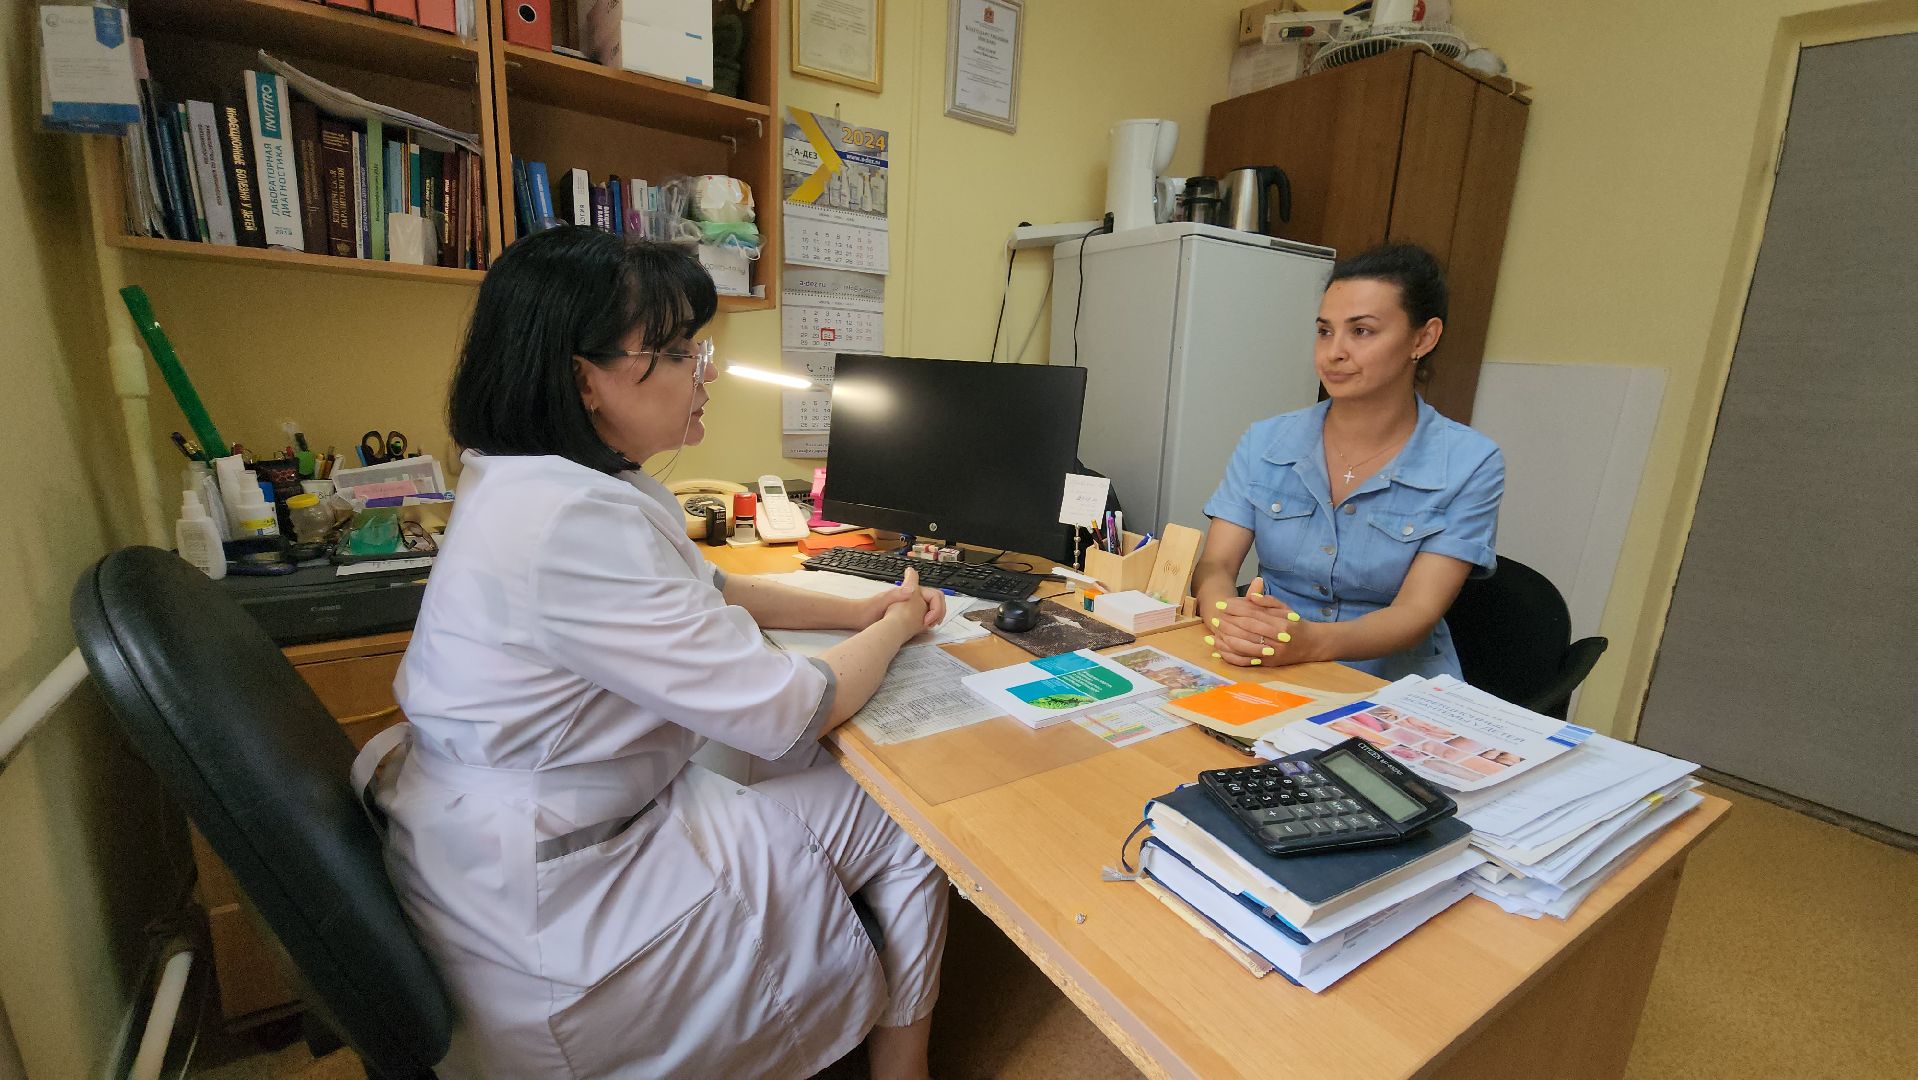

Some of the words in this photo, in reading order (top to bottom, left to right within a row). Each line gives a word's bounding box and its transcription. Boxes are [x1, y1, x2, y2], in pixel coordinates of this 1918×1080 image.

[261, 84, 278, 132] INVITRO
[225, 106, 245, 165] ИНФЕКЦИОННЫЕ
[841, 127, 886, 151] 2024
[795, 148, 818, 159] А-ДЕЗ
[235, 168, 251, 202] БОЛЕЗНИ
[264, 143, 281, 217] ЛАБОРАТОРНАЯ
[275, 145, 292, 218] ДИАГНОСТИКА
[241, 208, 257, 231] ДЕТЕЙ
[1358, 742, 1383, 760] CITIZEN
